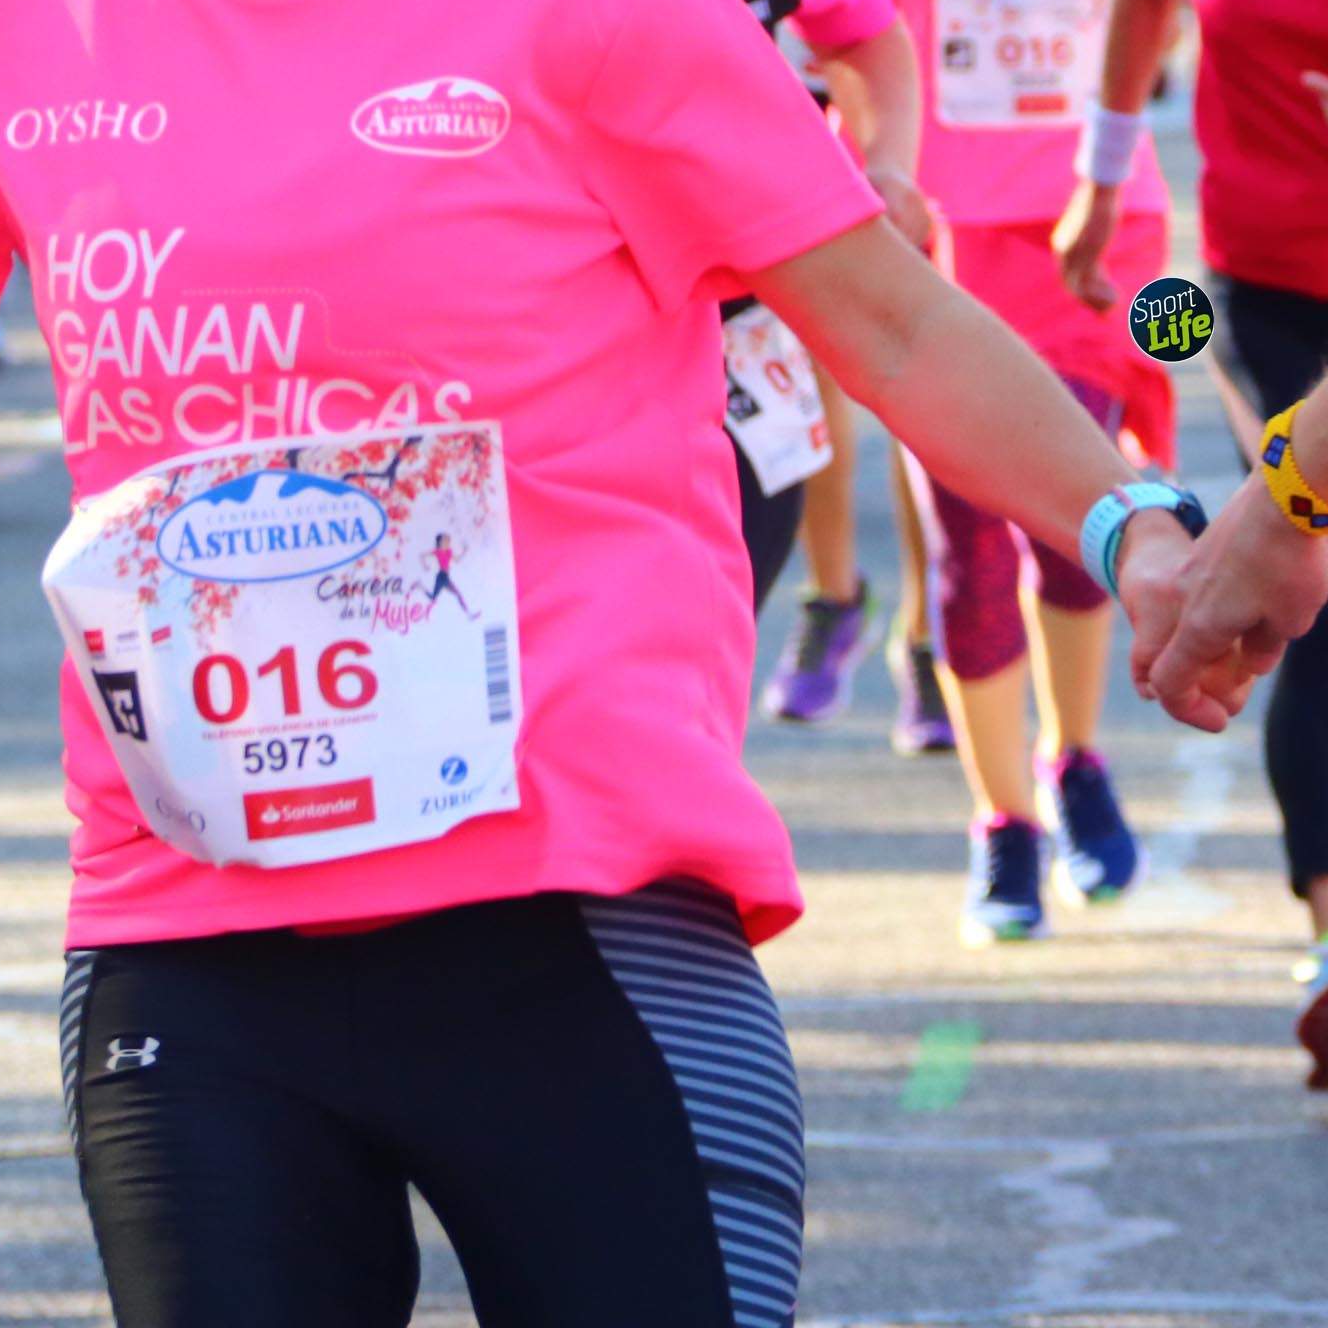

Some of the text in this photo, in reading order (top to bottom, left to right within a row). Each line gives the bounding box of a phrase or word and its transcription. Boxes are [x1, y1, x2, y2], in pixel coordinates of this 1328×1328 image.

[5, 101, 168, 151] OYSHO
[47, 227, 185, 304] HOY
[53, 302, 305, 380] GANAN
[63, 377, 471, 455] LAS CHICAS
[174, 516, 370, 562] ASTURIANA
[317, 575, 404, 602] Carrera
[340, 600, 354, 620] de
[371, 592, 436, 636] Mujer
[191, 638, 380, 725] 016
[242, 733, 339, 775] 5973
[282, 794, 359, 821] Santander
